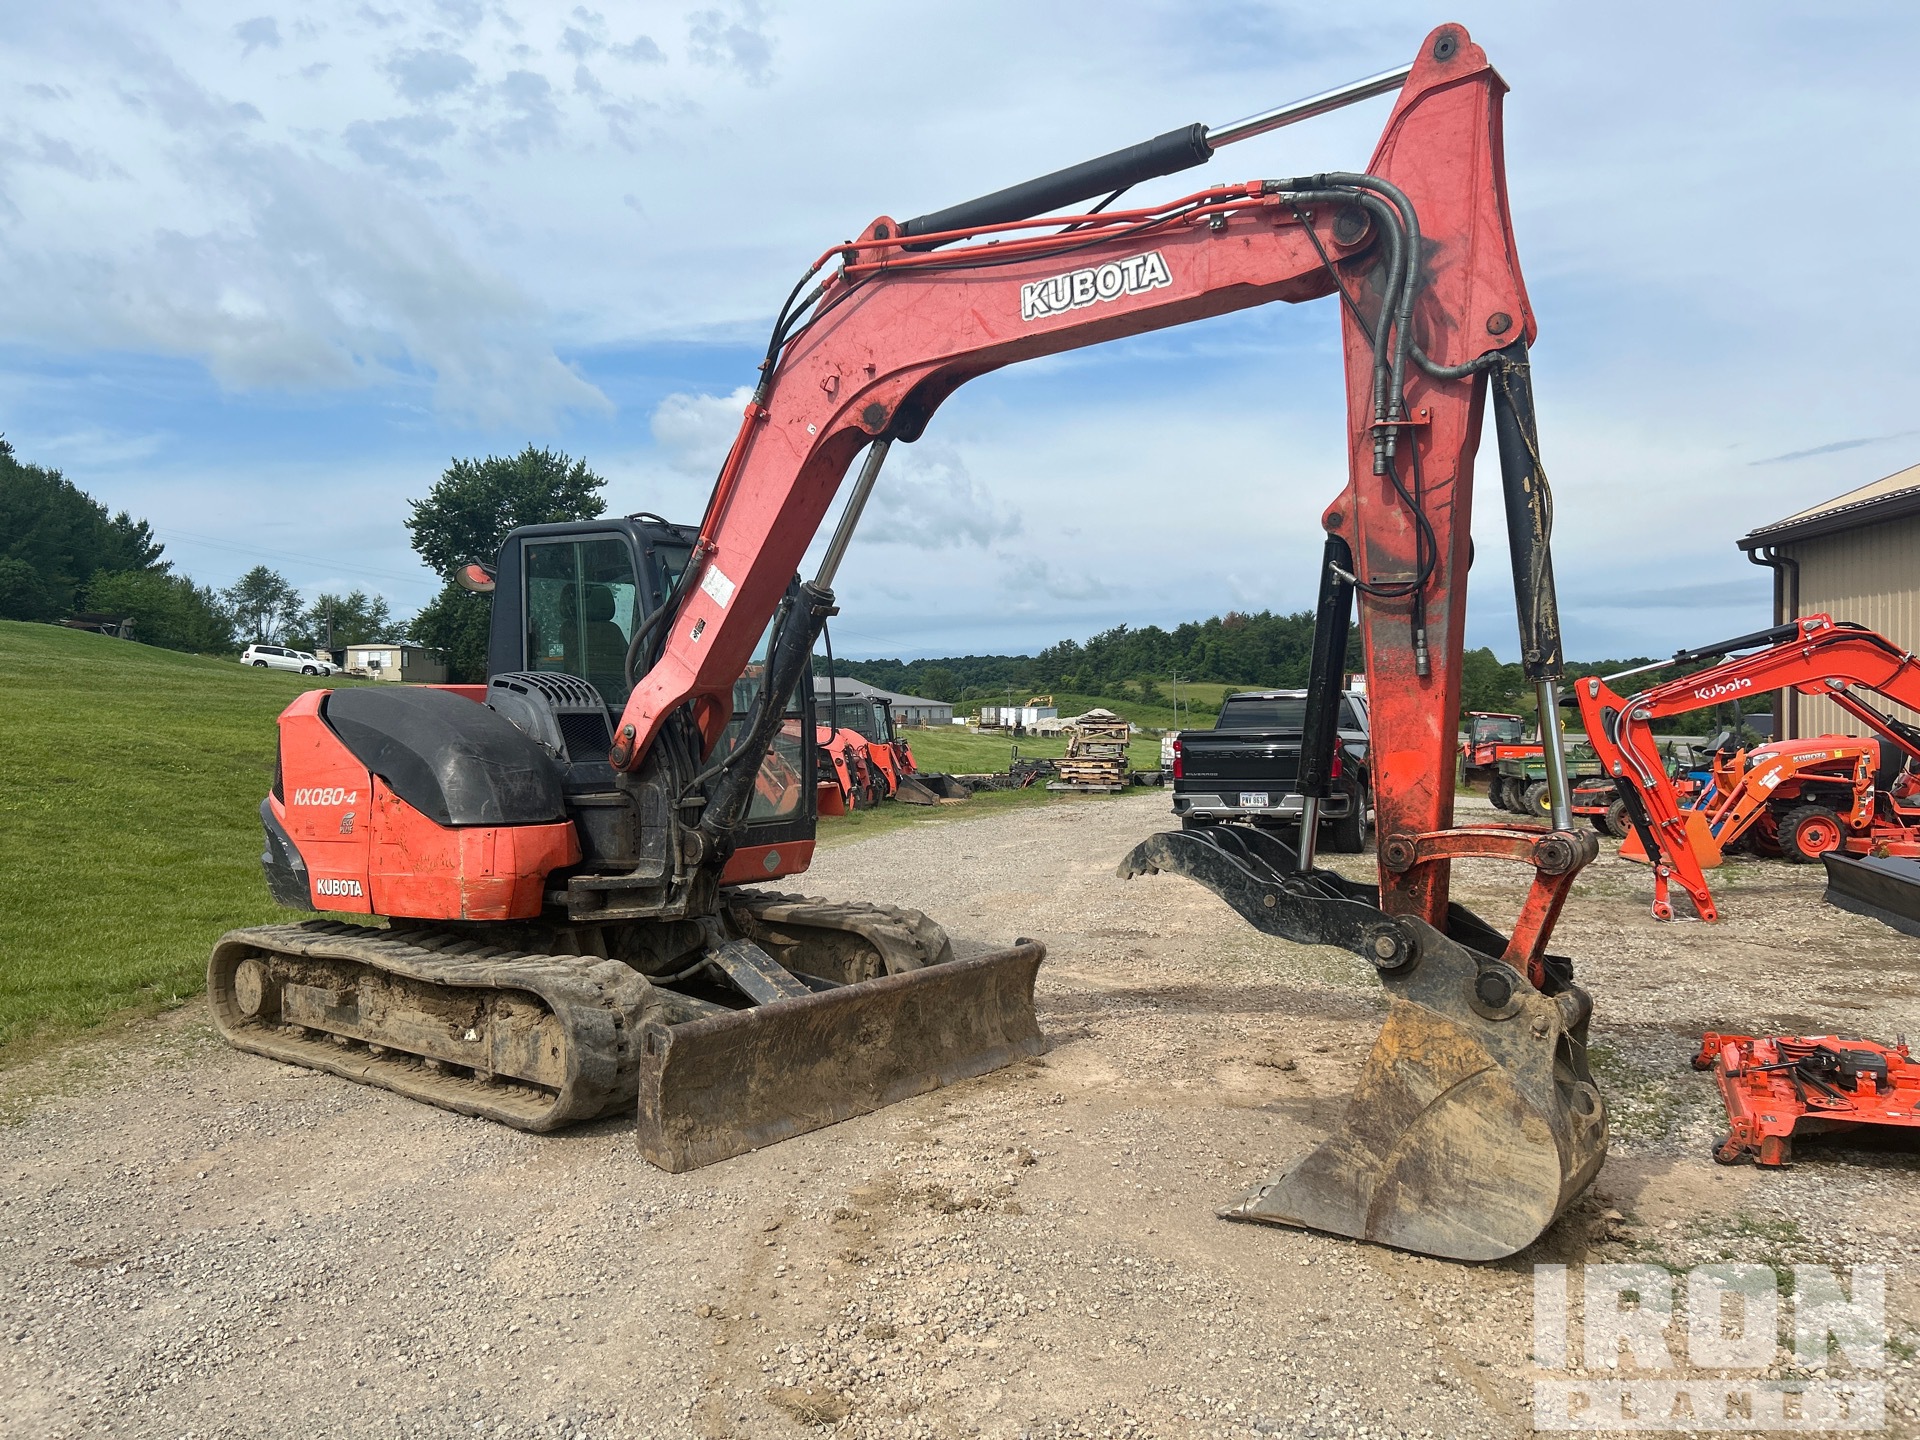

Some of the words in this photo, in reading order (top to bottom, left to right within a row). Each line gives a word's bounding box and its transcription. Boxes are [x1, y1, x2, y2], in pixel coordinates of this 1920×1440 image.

[1022, 251, 1171, 320] KUBOTA
[1352, 674, 1366, 682] ADUL
[1694, 677, 1751, 700] Kubota
[1191, 750, 1300, 758] CHEVROLE
[1793, 752, 1827, 763] KUBOTA
[293, 787, 357, 806] KX080-4
[316, 878, 363, 897] KUBOTA
